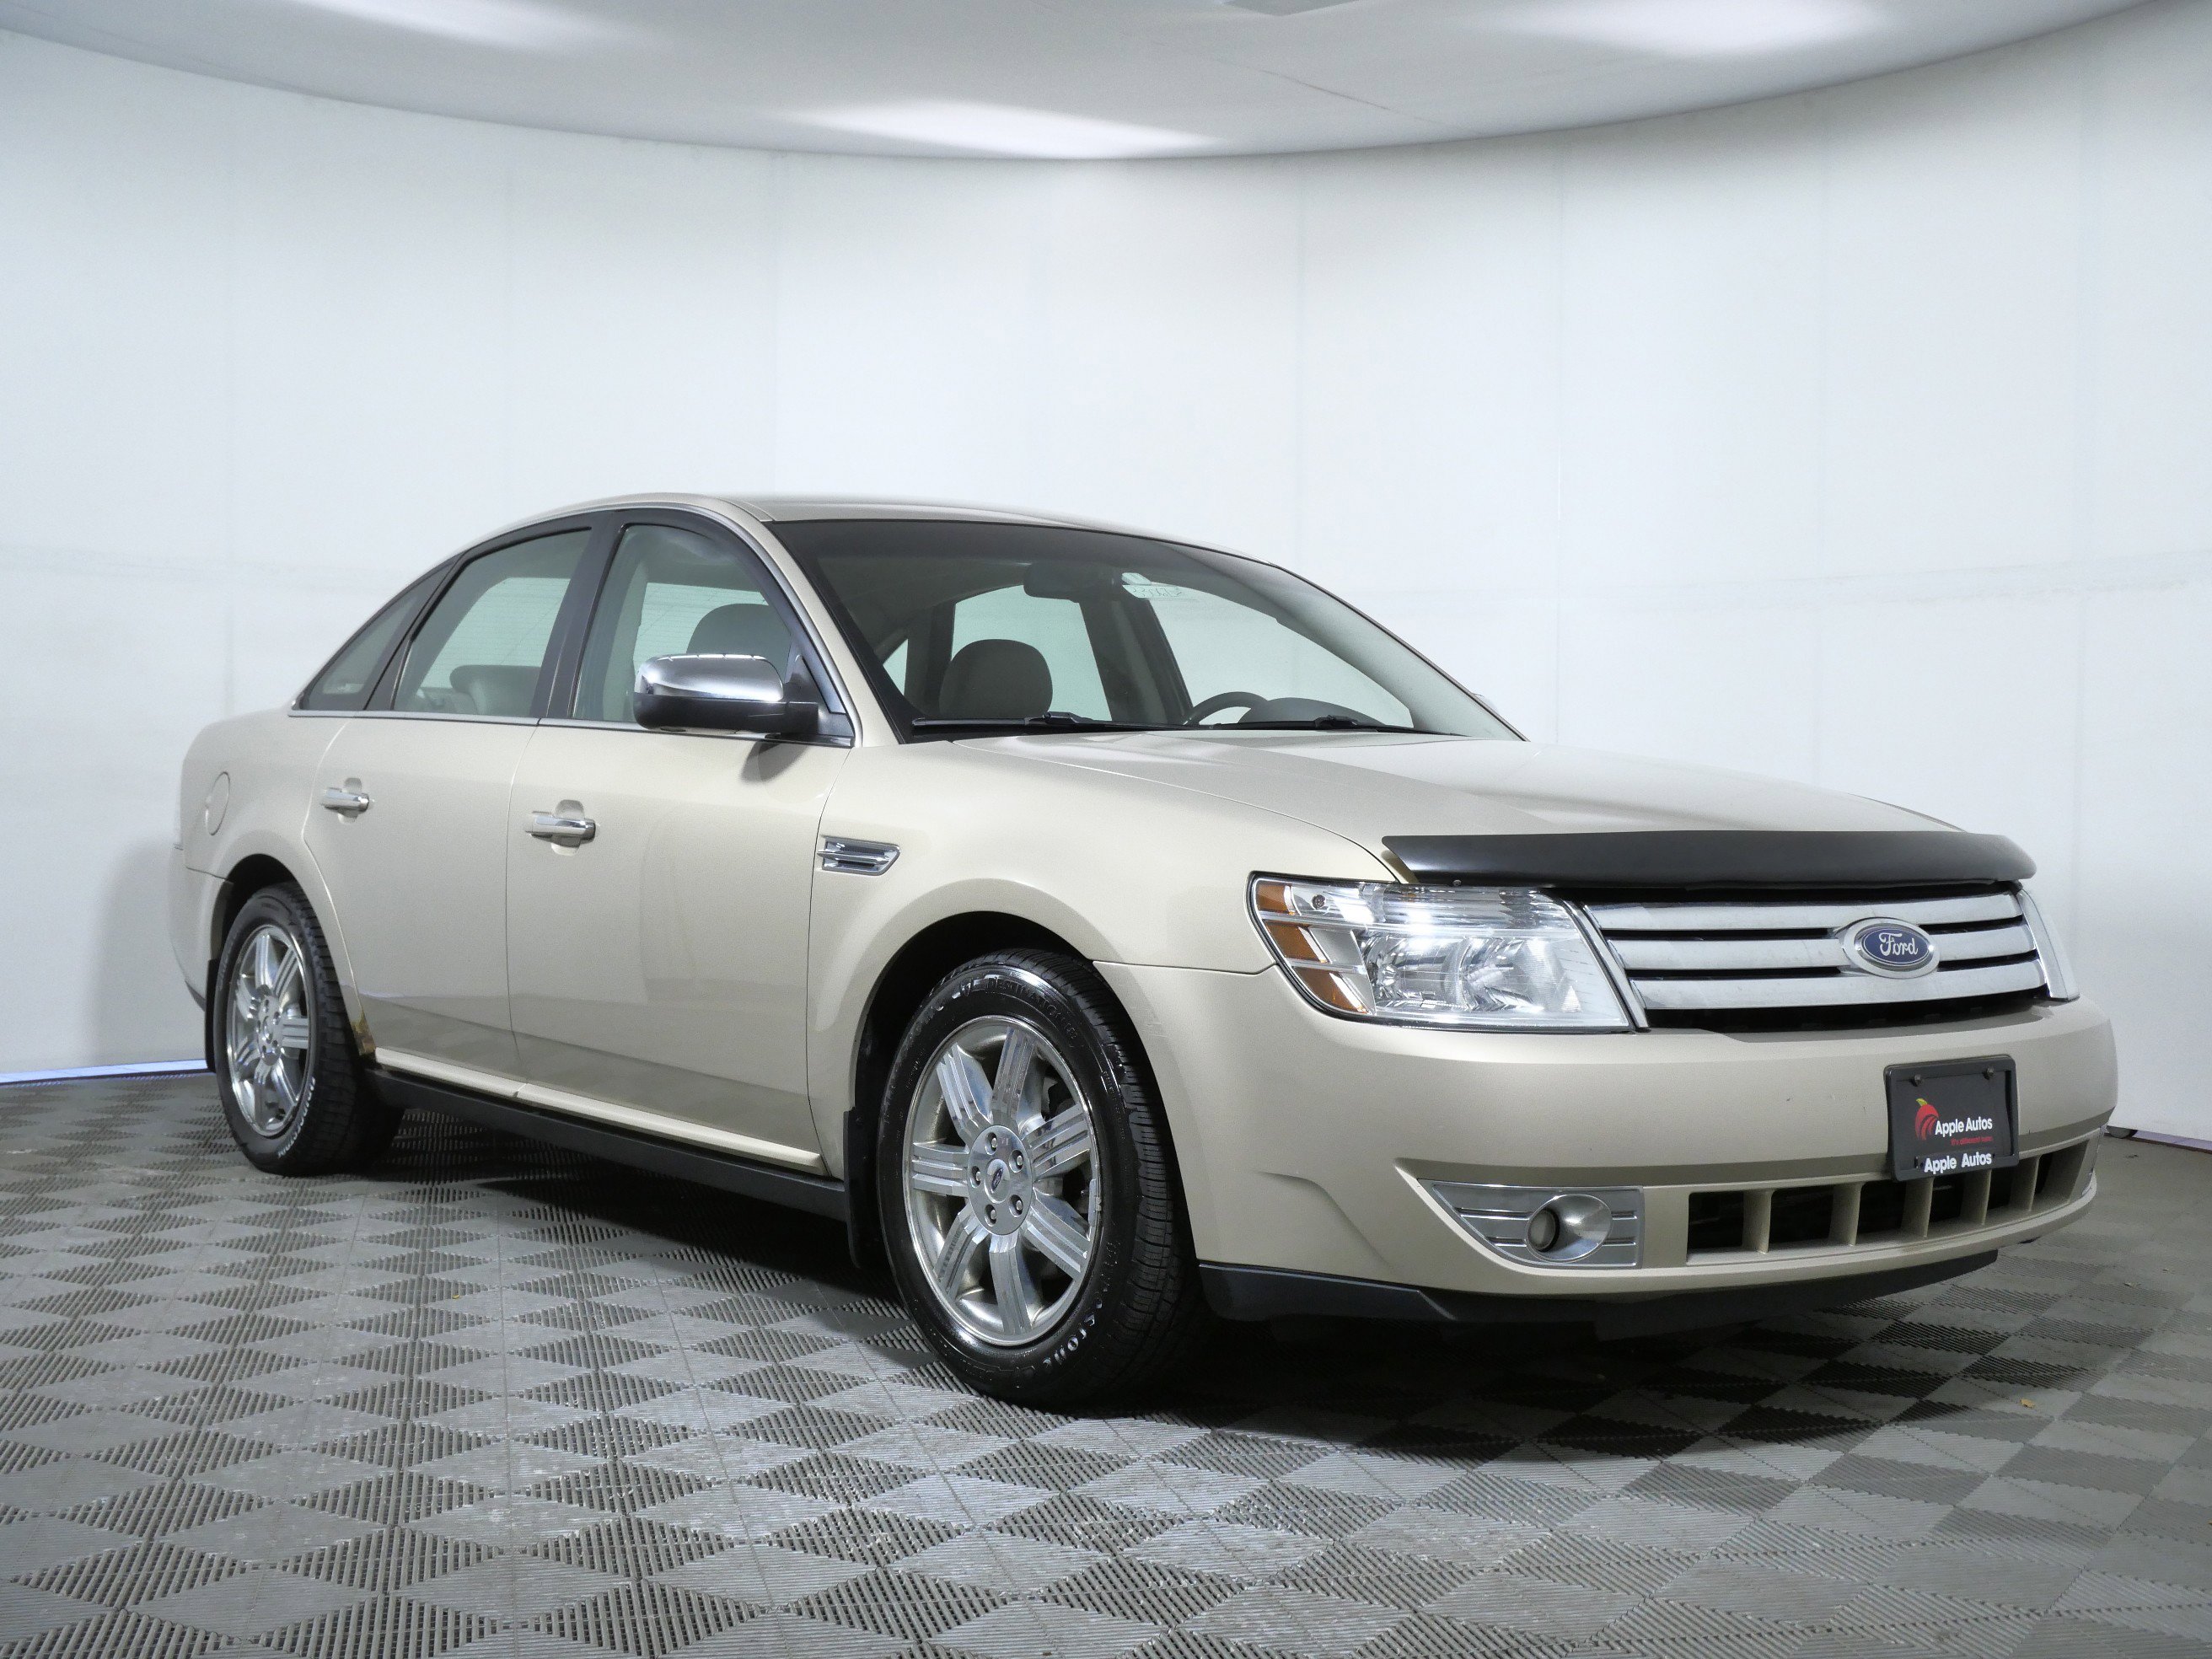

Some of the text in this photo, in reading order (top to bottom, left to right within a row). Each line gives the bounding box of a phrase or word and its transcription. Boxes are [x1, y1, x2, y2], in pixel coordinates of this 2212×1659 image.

[1879, 932, 1919, 957] Ford
[1935, 1116, 1993, 1138] Apple Autos
[1924, 1152, 1992, 1175] Apple Autos
